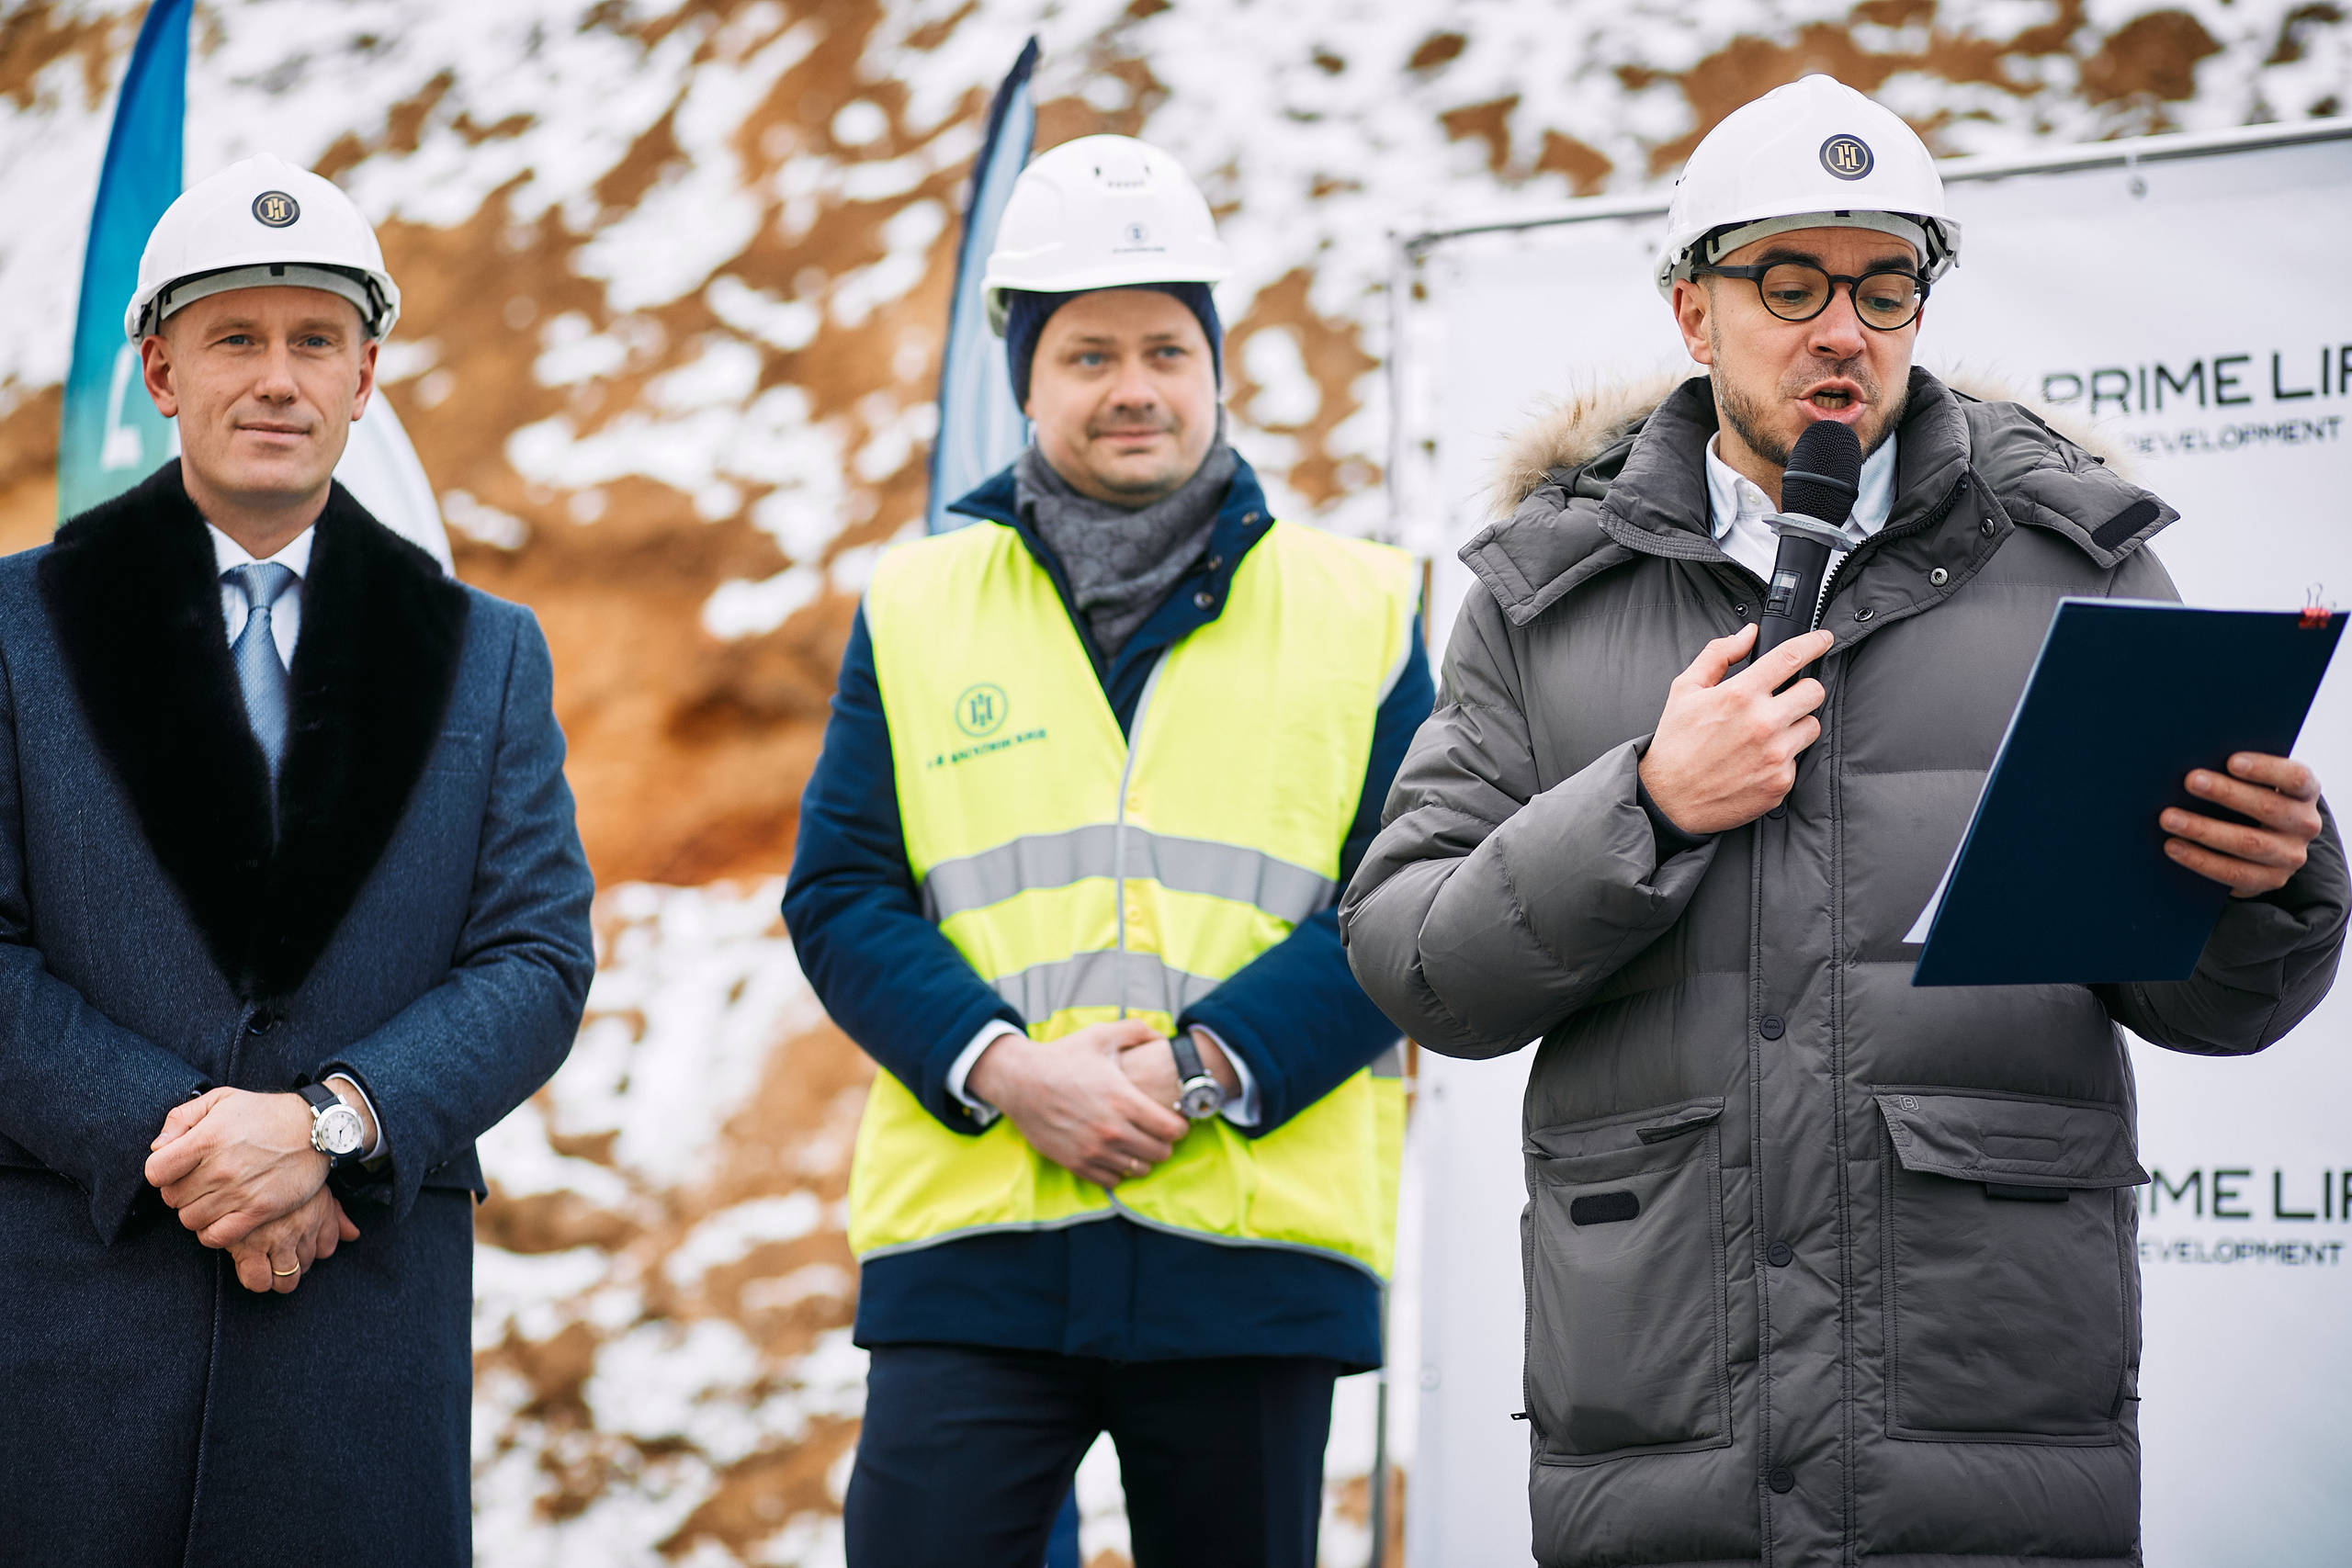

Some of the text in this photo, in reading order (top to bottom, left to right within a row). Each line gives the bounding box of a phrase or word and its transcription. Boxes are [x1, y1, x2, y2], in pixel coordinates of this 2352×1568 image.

[2041, 355, 2252, 414] PRIME
[1791, 518, 1815, 529] MIC
[2139, 1240, 2344, 1265] EVELOPMENT
